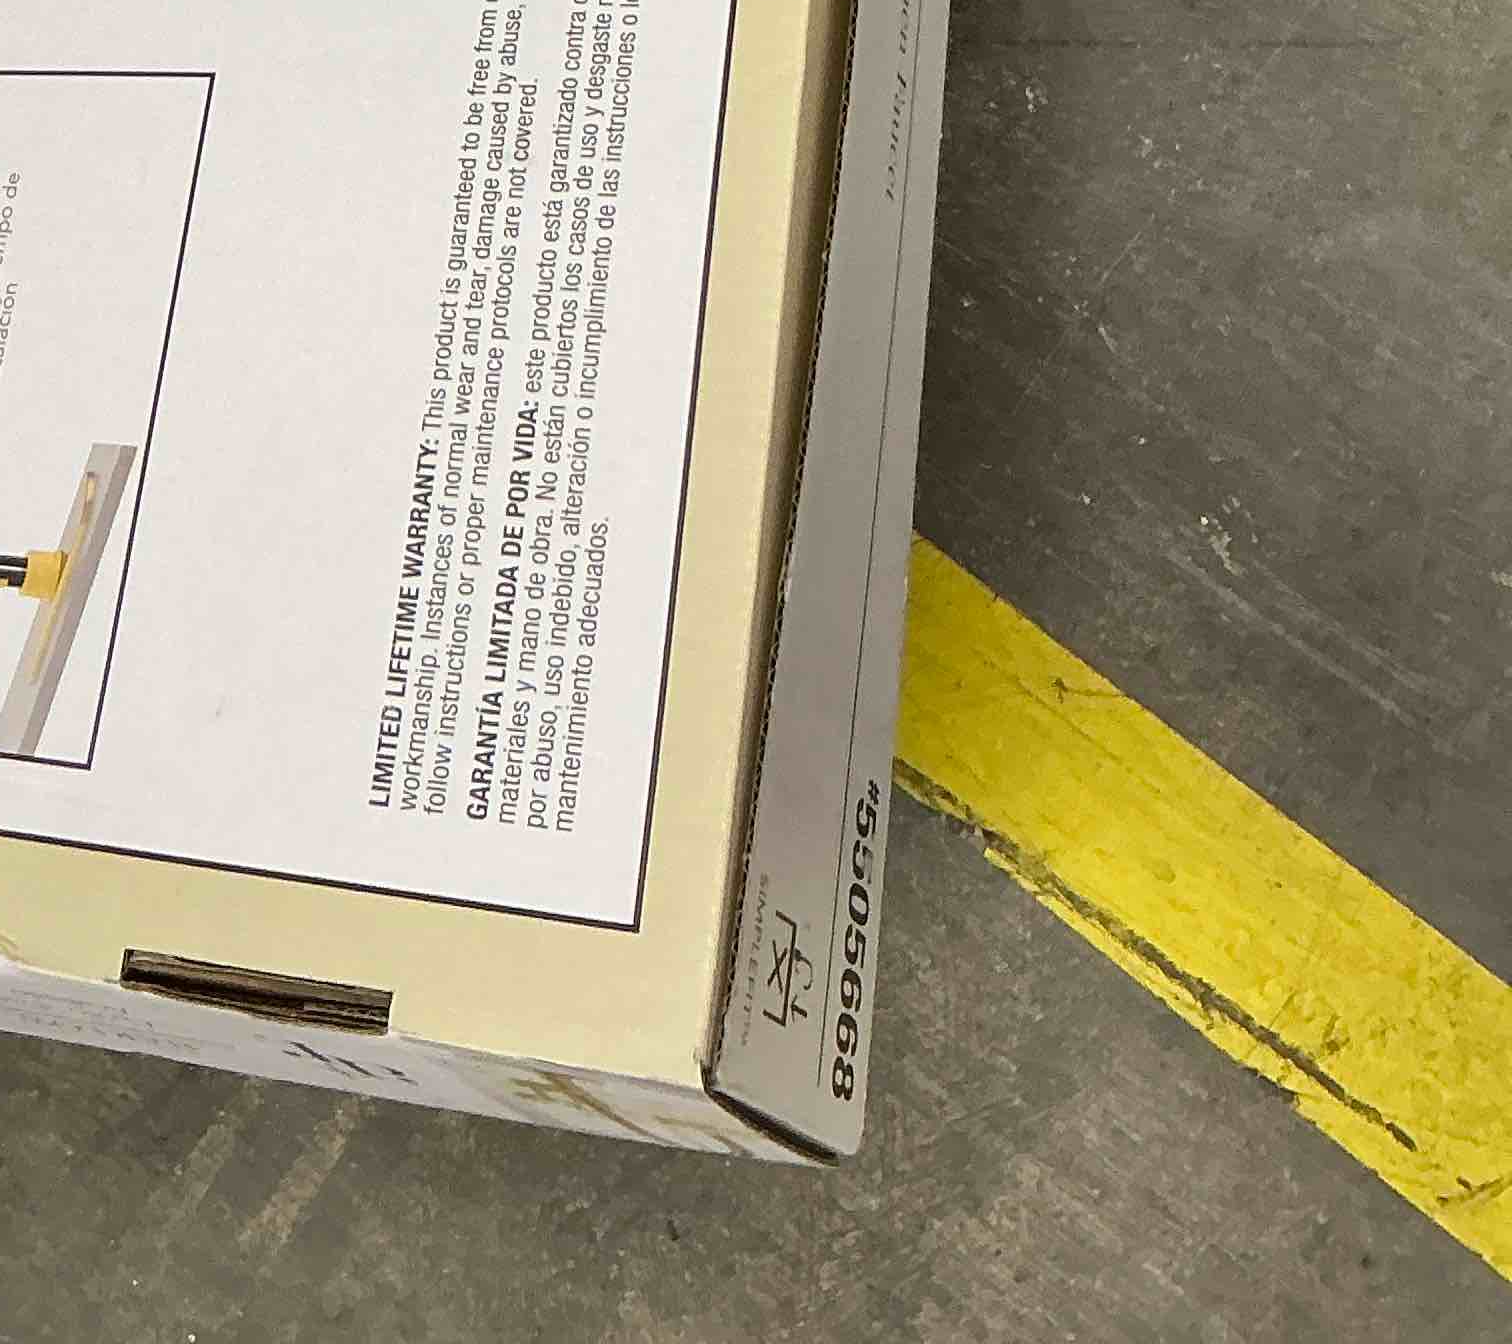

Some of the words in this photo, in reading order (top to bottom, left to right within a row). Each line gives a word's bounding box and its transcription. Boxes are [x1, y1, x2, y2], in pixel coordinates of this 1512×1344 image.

[473, 8, 499, 52] from
[466, 58, 494, 95] free
[463, 101, 484, 125] be
[461, 131, 480, 151] to
[1, 171, 20, 198] de
[447, 156, 477, 270] guaranteed
[440, 277, 461, 293] is
[433, 300, 458, 380] product
[421, 387, 446, 430] This
[401, 438, 440, 577] WARRANTY:
[385, 585, 420, 697] LIFETIME
[368, 704, 402, 807] LIMITED
[831, 779, 878, 1101] #5505668
